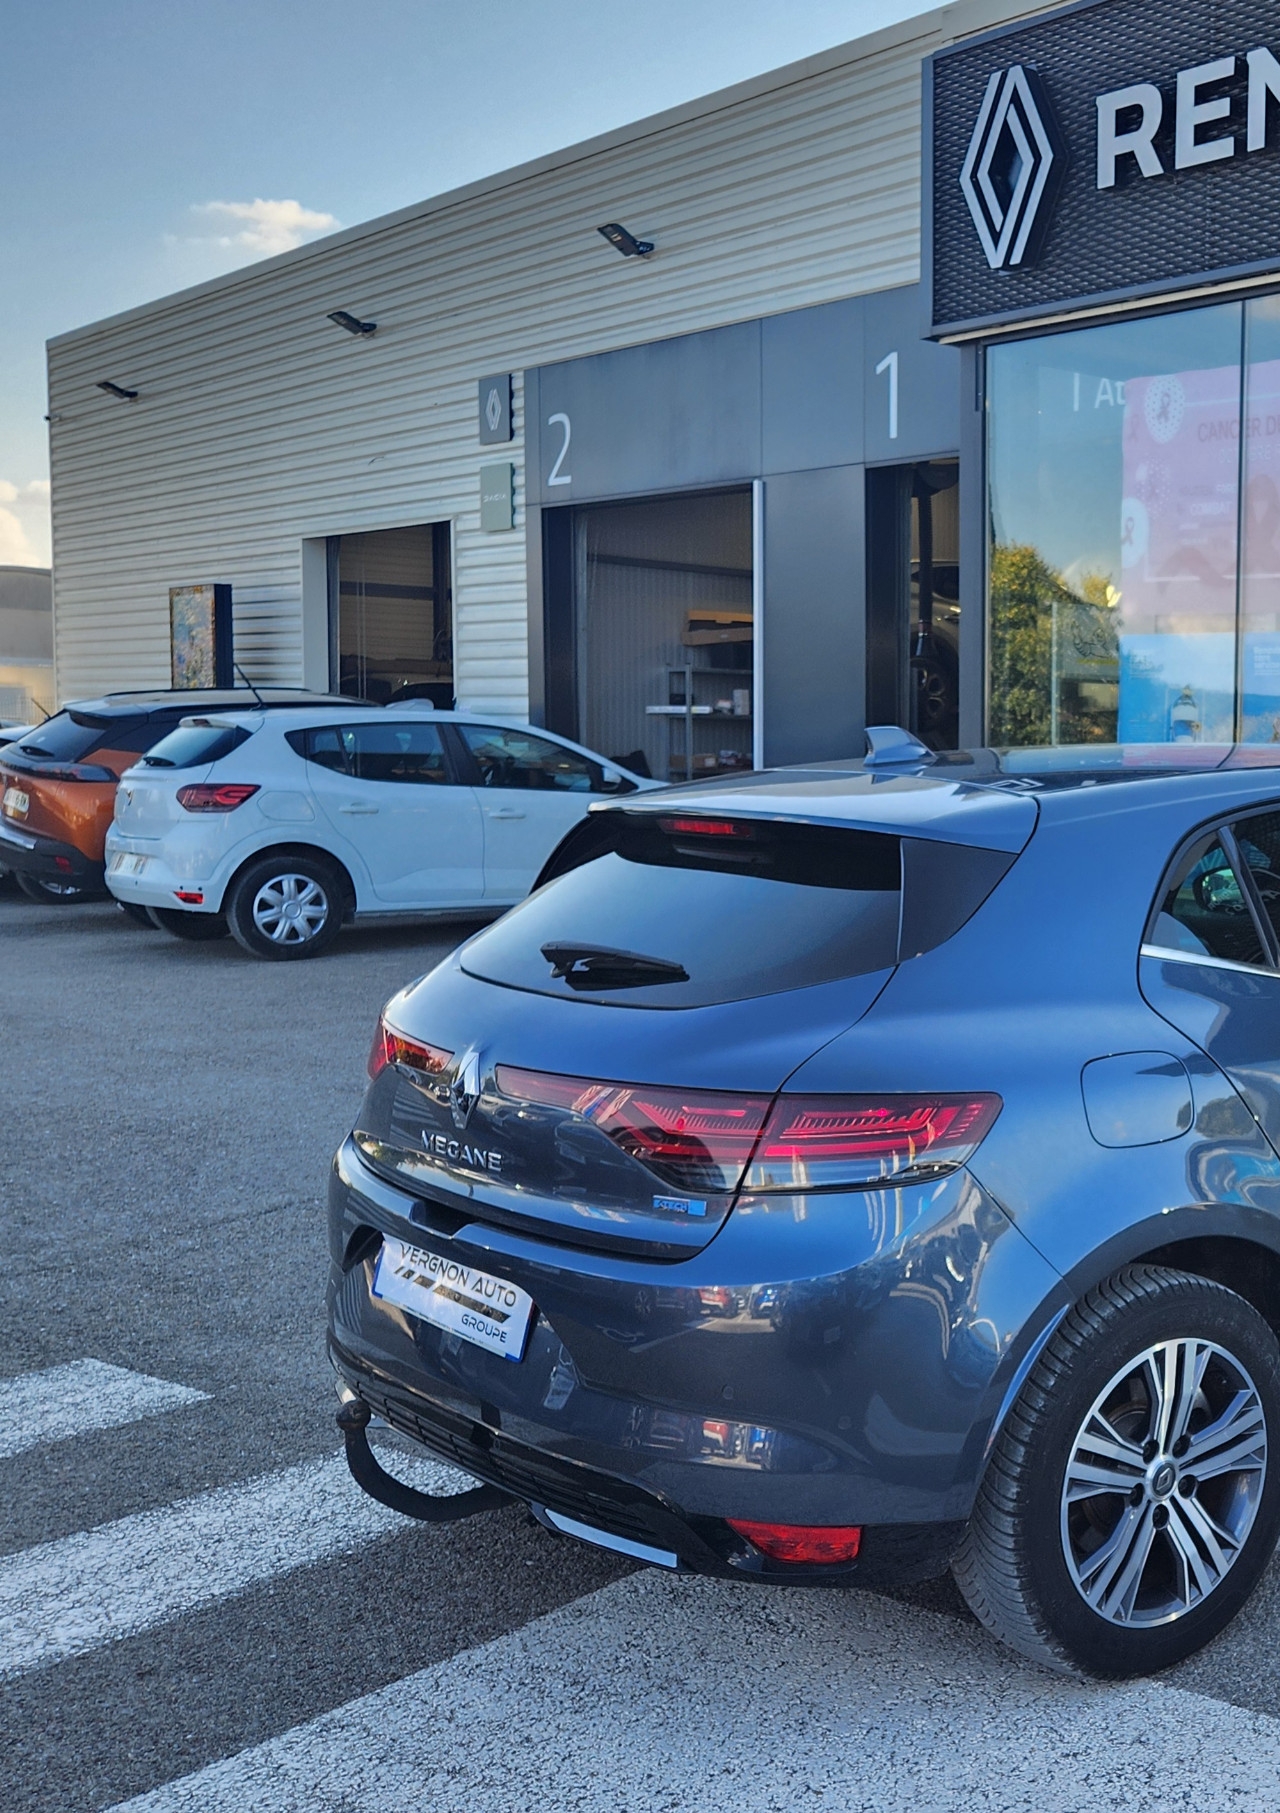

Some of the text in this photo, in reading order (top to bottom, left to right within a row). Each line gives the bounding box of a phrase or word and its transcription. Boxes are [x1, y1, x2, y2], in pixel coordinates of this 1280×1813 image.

[876, 352, 898, 439] 1
[548, 412, 572, 486] 2
[421, 1130, 504, 1171] MEGANE
[400, 1242, 517, 1307] VERGNON AUTO
[461, 1314, 508, 1343] GROUPE
